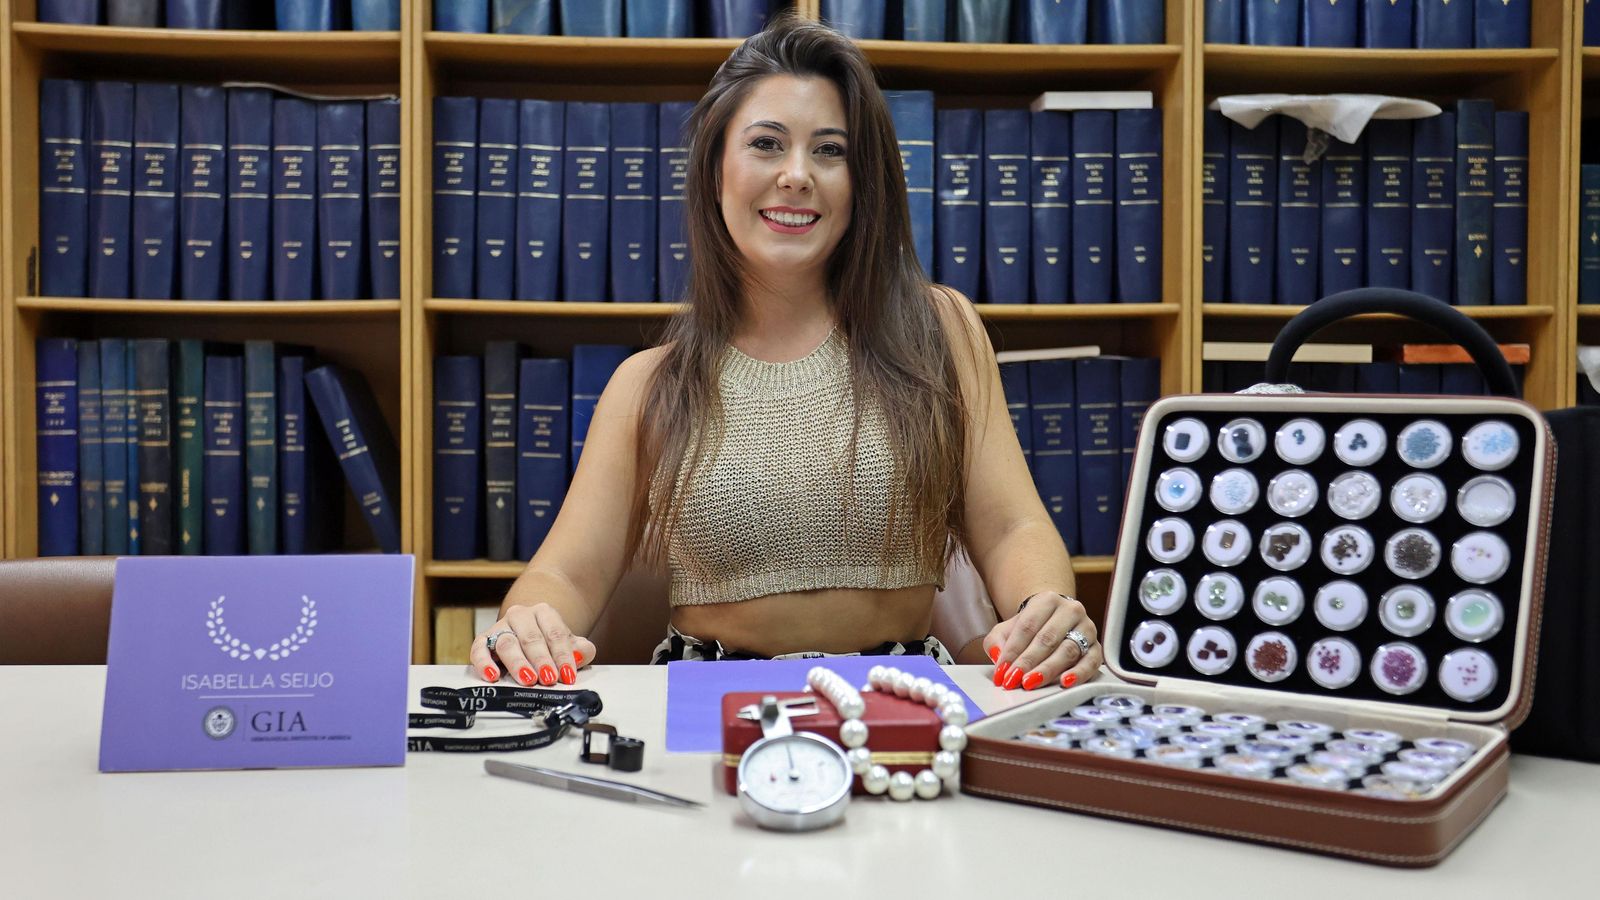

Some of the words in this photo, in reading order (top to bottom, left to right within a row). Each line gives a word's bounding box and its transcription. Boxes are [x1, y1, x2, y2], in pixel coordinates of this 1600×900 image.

[181, 673, 275, 690] ISABELLA
[279, 671, 334, 689] SEIJO
[472, 687, 497, 698] GIA
[458, 697, 487, 711] GIA
[251, 711, 307, 733] GIA
